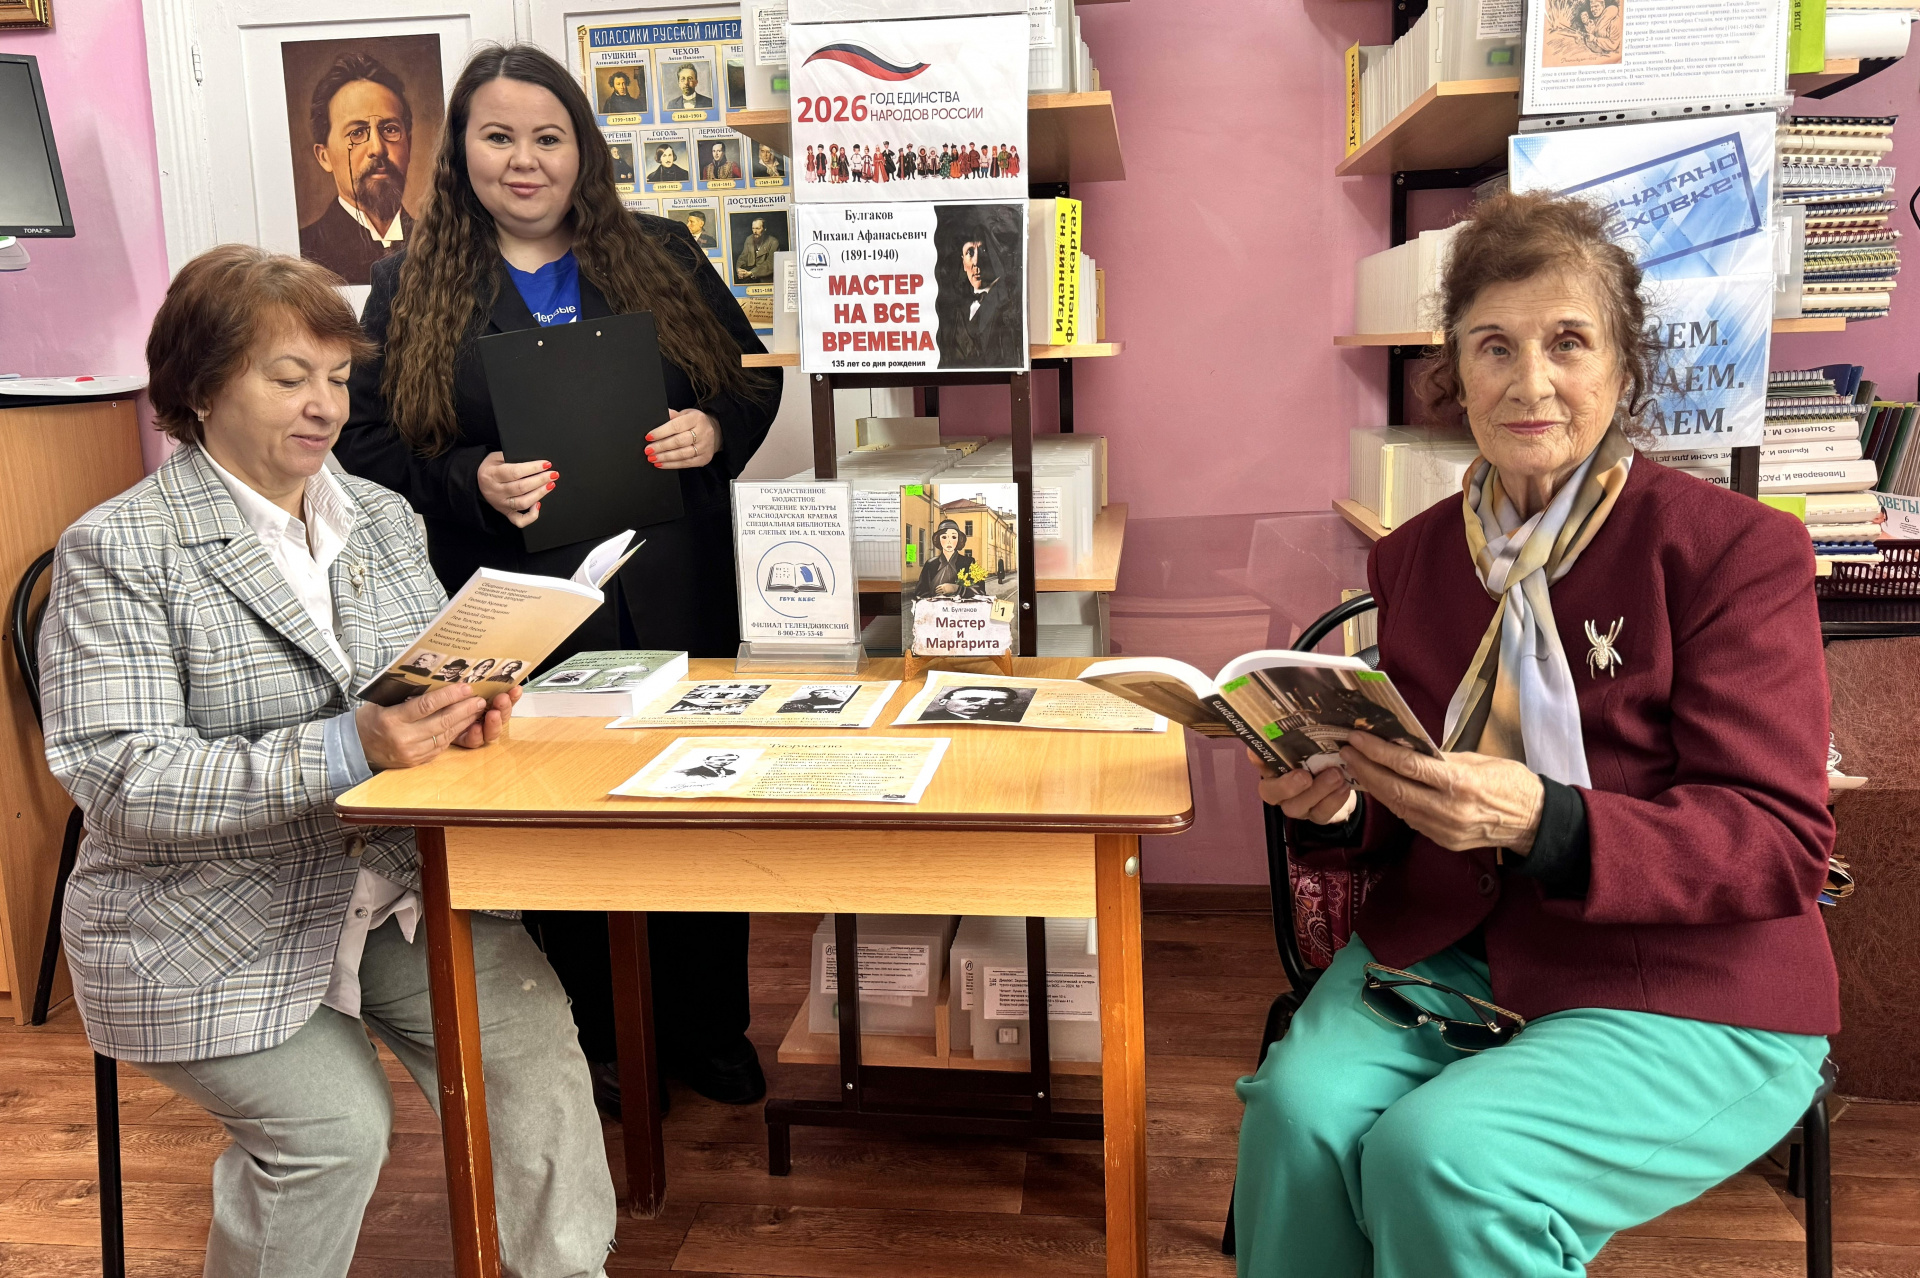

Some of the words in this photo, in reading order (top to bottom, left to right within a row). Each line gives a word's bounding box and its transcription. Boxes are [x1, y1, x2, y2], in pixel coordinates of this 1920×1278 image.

[594, 28, 649, 46] КЛАССИКИ
[652, 22, 701, 42] РУССКОЙ
[704, 20, 742, 40] ЛИТЕР
[602, 51, 637, 60] ПУШКИН
[672, 47, 700, 56] ЧЕХОВ
[870, 92, 895, 105] ГОД
[898, 90, 960, 104] ЕДИНСТВА
[797, 94, 868, 122] 2026
[870, 108, 929, 122] НАРОДОВ
[931, 107, 983, 120] РОССИИ
[727, 195, 786, 205] ДОСТОЕВСКИЙ
[844, 209, 894, 222] Булгаков
[1060, 212, 1066, 236] на
[812, 230, 854, 242] Михаил
[856, 228, 928, 243] Афанасьевич
[840, 248, 899, 263] (1891-1940)
[1066, 203, 1077, 343] флеш-картах
[828, 273, 924, 296] МАСТЕР
[1056, 244, 1066, 332] Издания
[834, 303, 868, 324] НА
[874, 302, 920, 324] ВСЕ
[822, 330, 936, 352] ВРЕМЕНА
[831, 360, 846, 368] 135
[873, 361, 887, 369] дня
[888, 360, 926, 369] рождения
[1784, 425, 1836, 434] Зощенко
[1000, 607, 1006, 616] 1
[936, 616, 986, 631] Мастер
[957, 631, 964, 639] и
[926, 637, 1000, 650] Маргарита
[1212, 700, 1250, 735] Маргарита
[1251, 739, 1277, 762] Мастер
